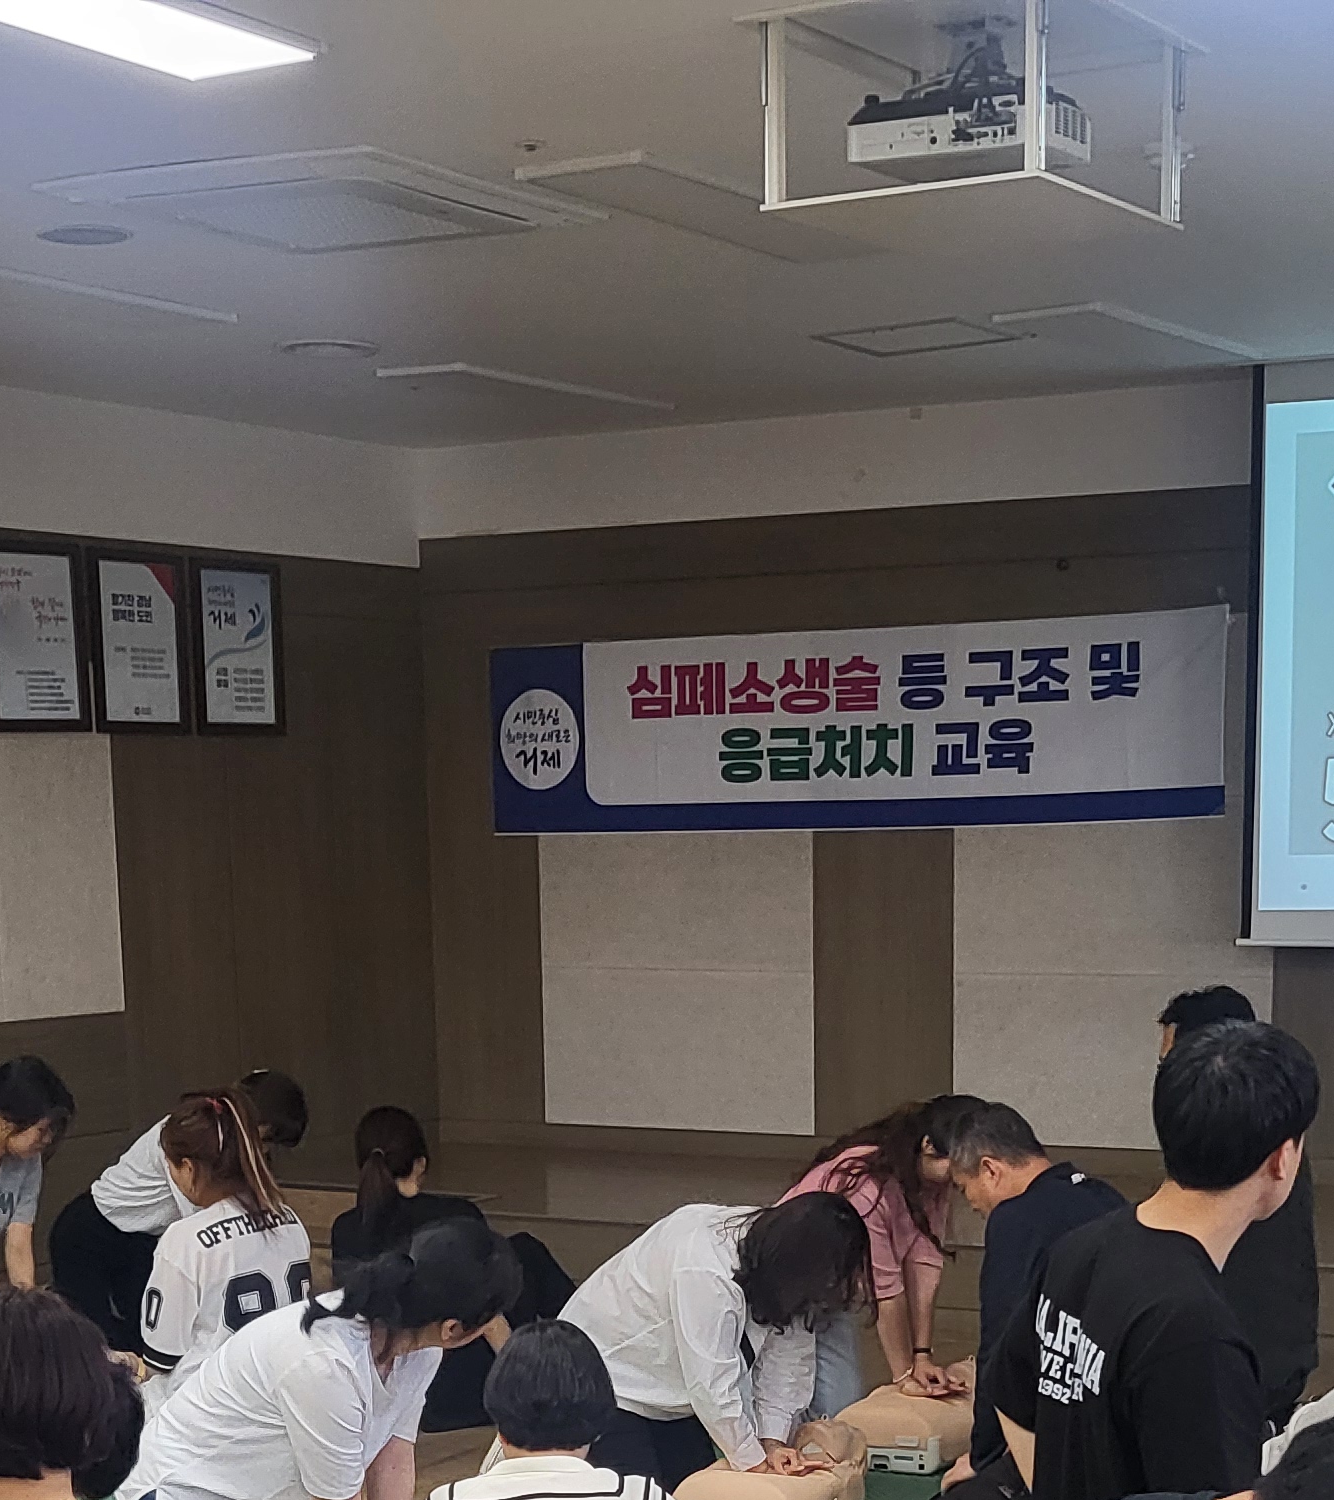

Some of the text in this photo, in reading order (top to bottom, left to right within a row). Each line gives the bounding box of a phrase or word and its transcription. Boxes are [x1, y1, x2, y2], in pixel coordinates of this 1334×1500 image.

[207, 609, 236, 631] 거제
[626, 640, 1142, 720] 심폐소생술 등 구조 및
[512, 707, 561, 727] 시민중심
[540, 729, 572, 744] 새로운
[717, 717, 1036, 785] 응급처치 교육
[514, 746, 562, 777] 거제
[1039, 1345, 1064, 1379] VE
[1037, 1377, 1072, 1405] 1992
